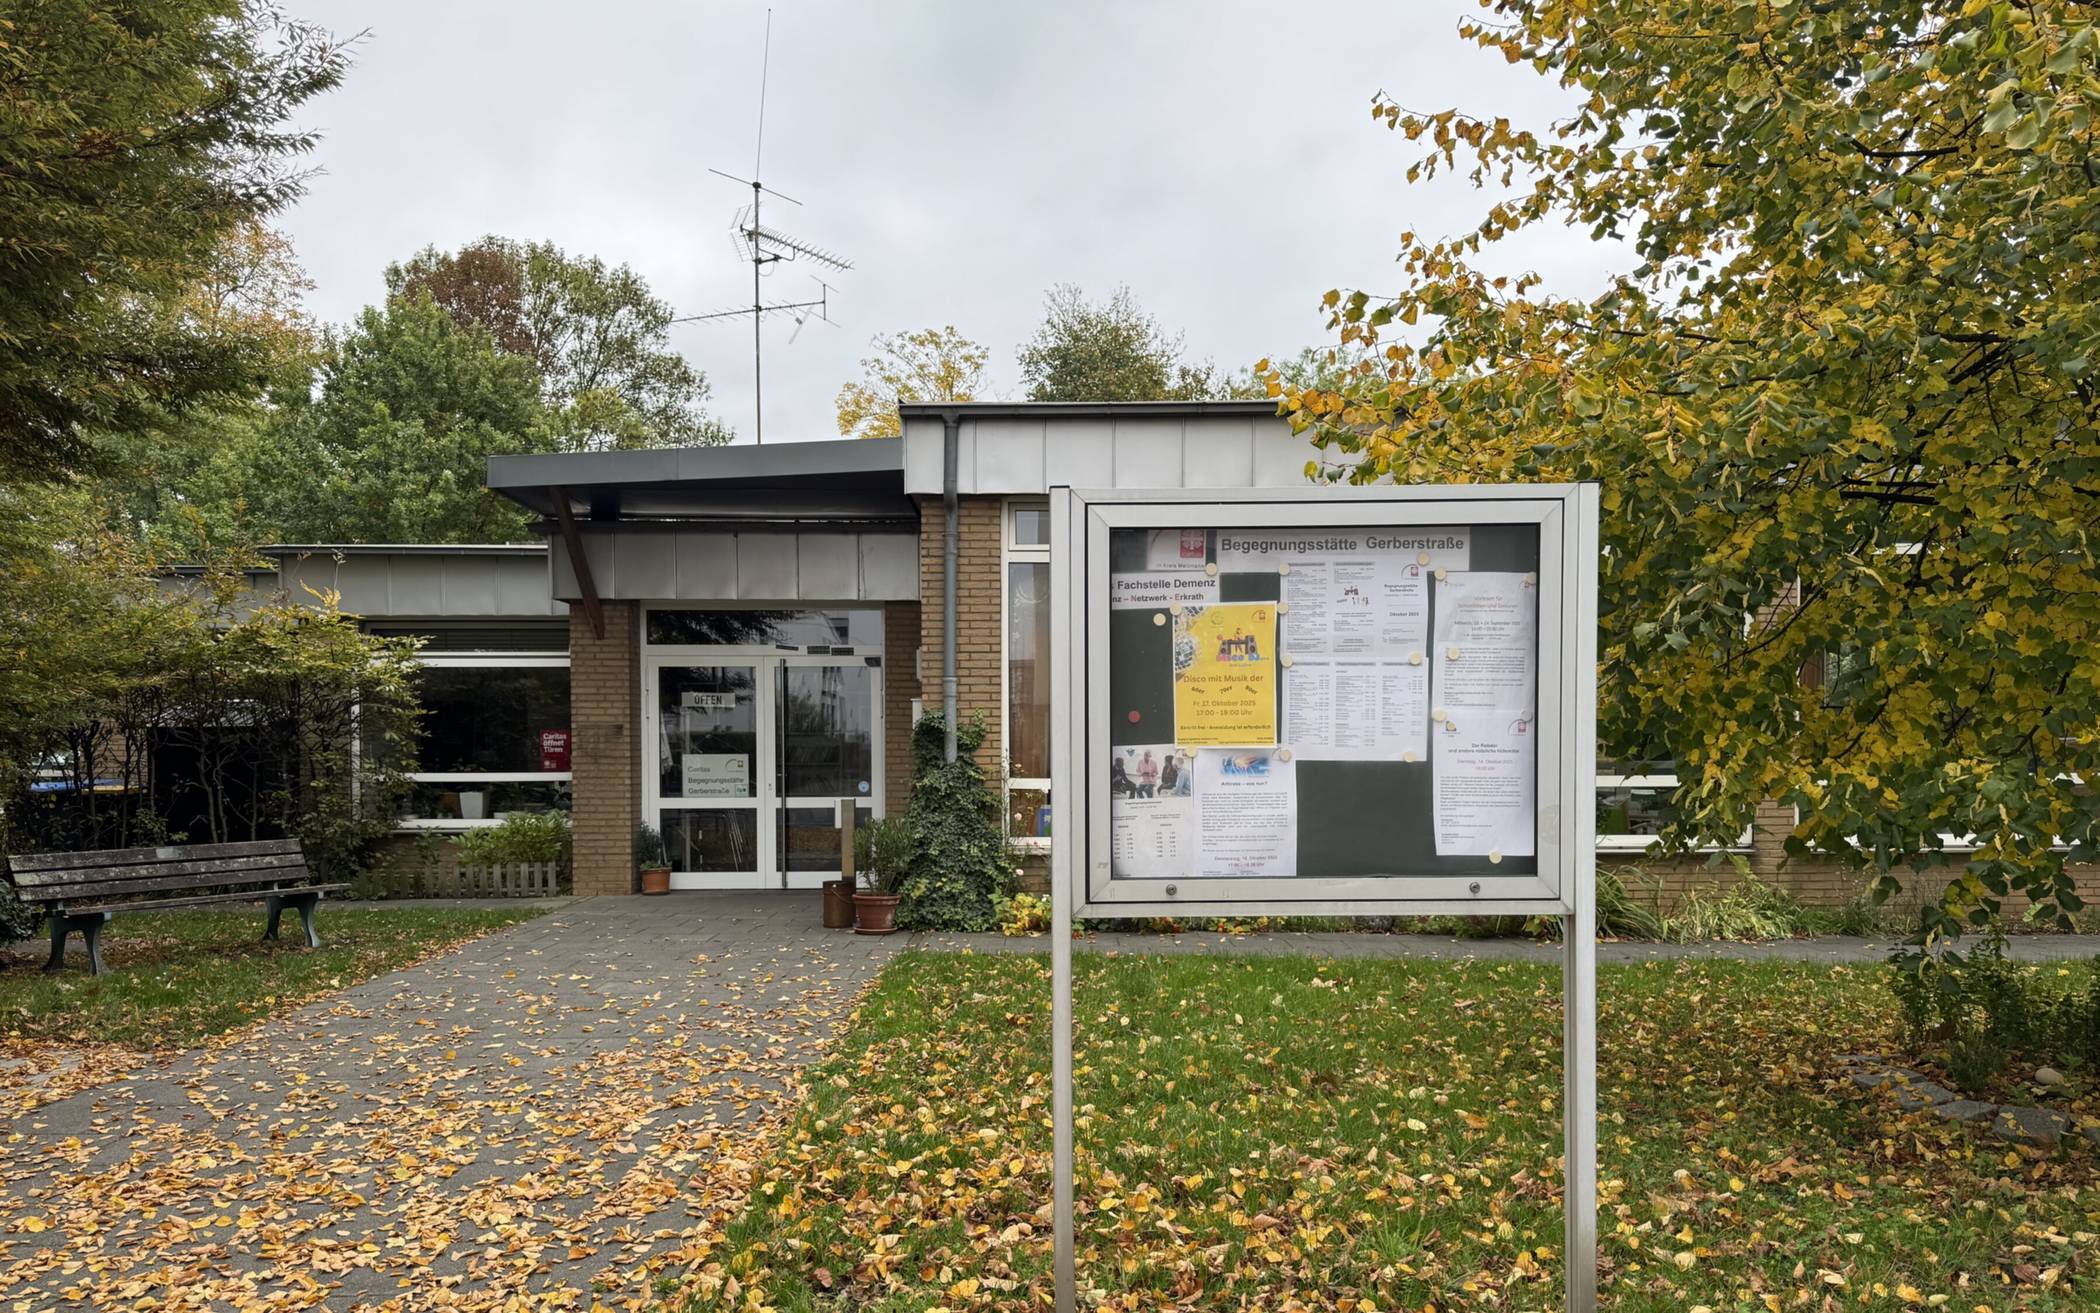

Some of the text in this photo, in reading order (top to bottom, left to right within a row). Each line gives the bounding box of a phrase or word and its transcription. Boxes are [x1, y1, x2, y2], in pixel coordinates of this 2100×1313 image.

[1221, 535, 1464, 554] Begegnungsstätte Gerberstraße
[1117, 578, 1216, 590] Fachstelle Demenz
[1130, 592, 1168, 603] Netzwerk
[1174, 592, 1204, 601] Erkrath
[1183, 673, 1264, 683] Disco mit Musik der
[694, 694, 722, 705] OFFEN
[1240, 708, 1254, 716] Uhr
[543, 739, 565, 747] öffnet
[687, 777, 745, 786] Begegnungsstätte
[688, 786, 730, 795] Gerberstraße
